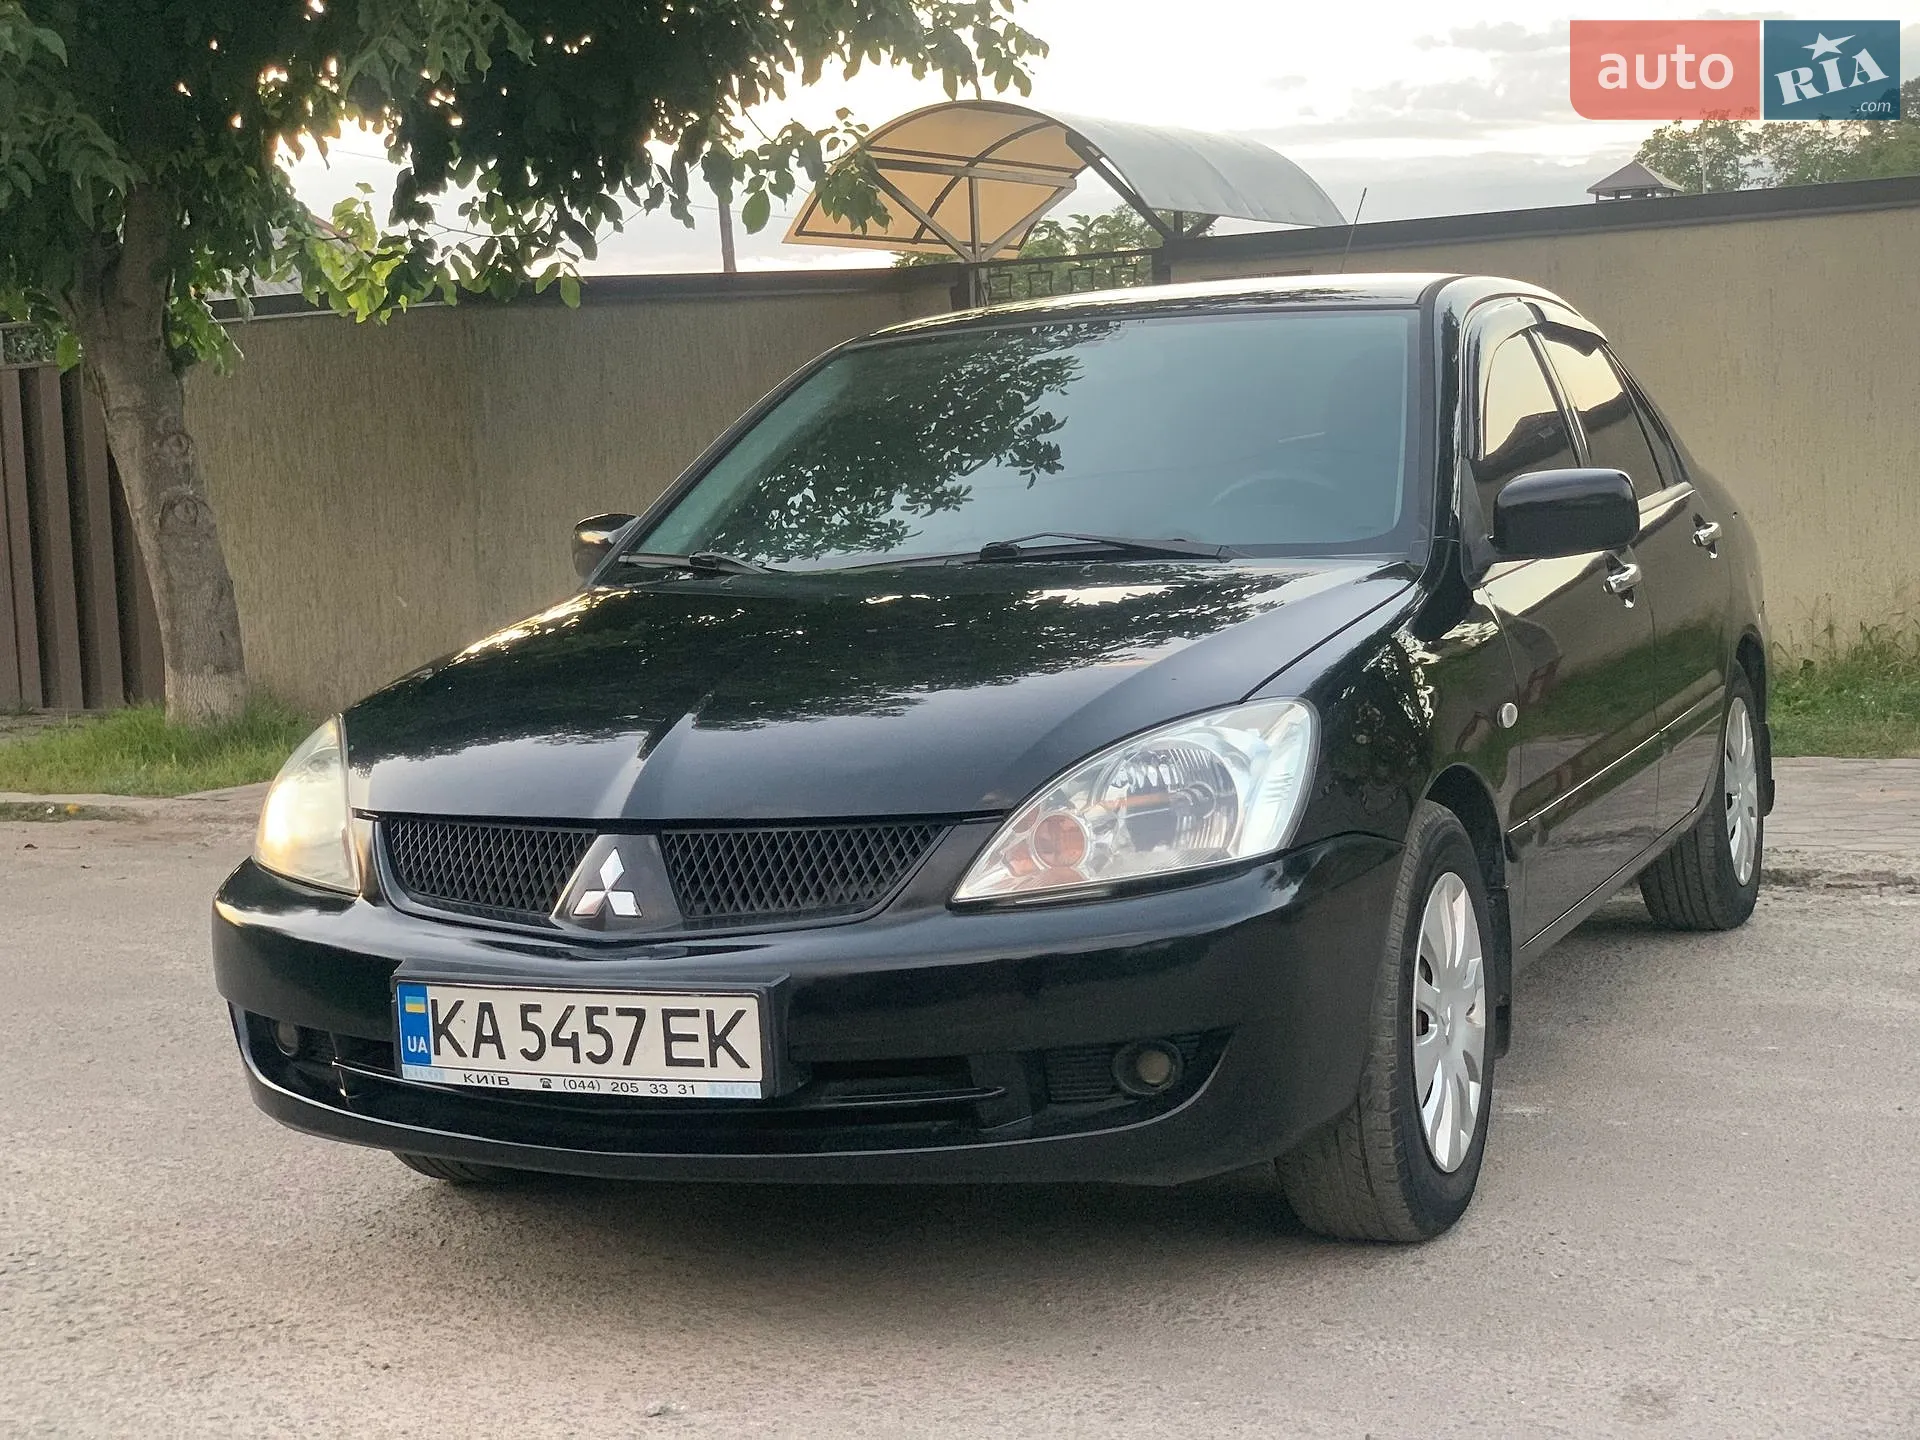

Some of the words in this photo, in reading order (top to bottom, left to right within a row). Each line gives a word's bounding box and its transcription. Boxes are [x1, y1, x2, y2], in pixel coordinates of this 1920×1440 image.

[407, 1035, 428, 1054] UA
[431, 998, 506, 1060] KA
[519, 1003, 646, 1066] 5457
[661, 1008, 751, 1068] EK
[463, 1072, 510, 1086] КИЇВ
[563, 1077, 600, 1092] (044)
[610, 1081, 639, 1093] 205
[650, 1083, 669, 1094] 33
[678, 1084, 696, 1095] 31
